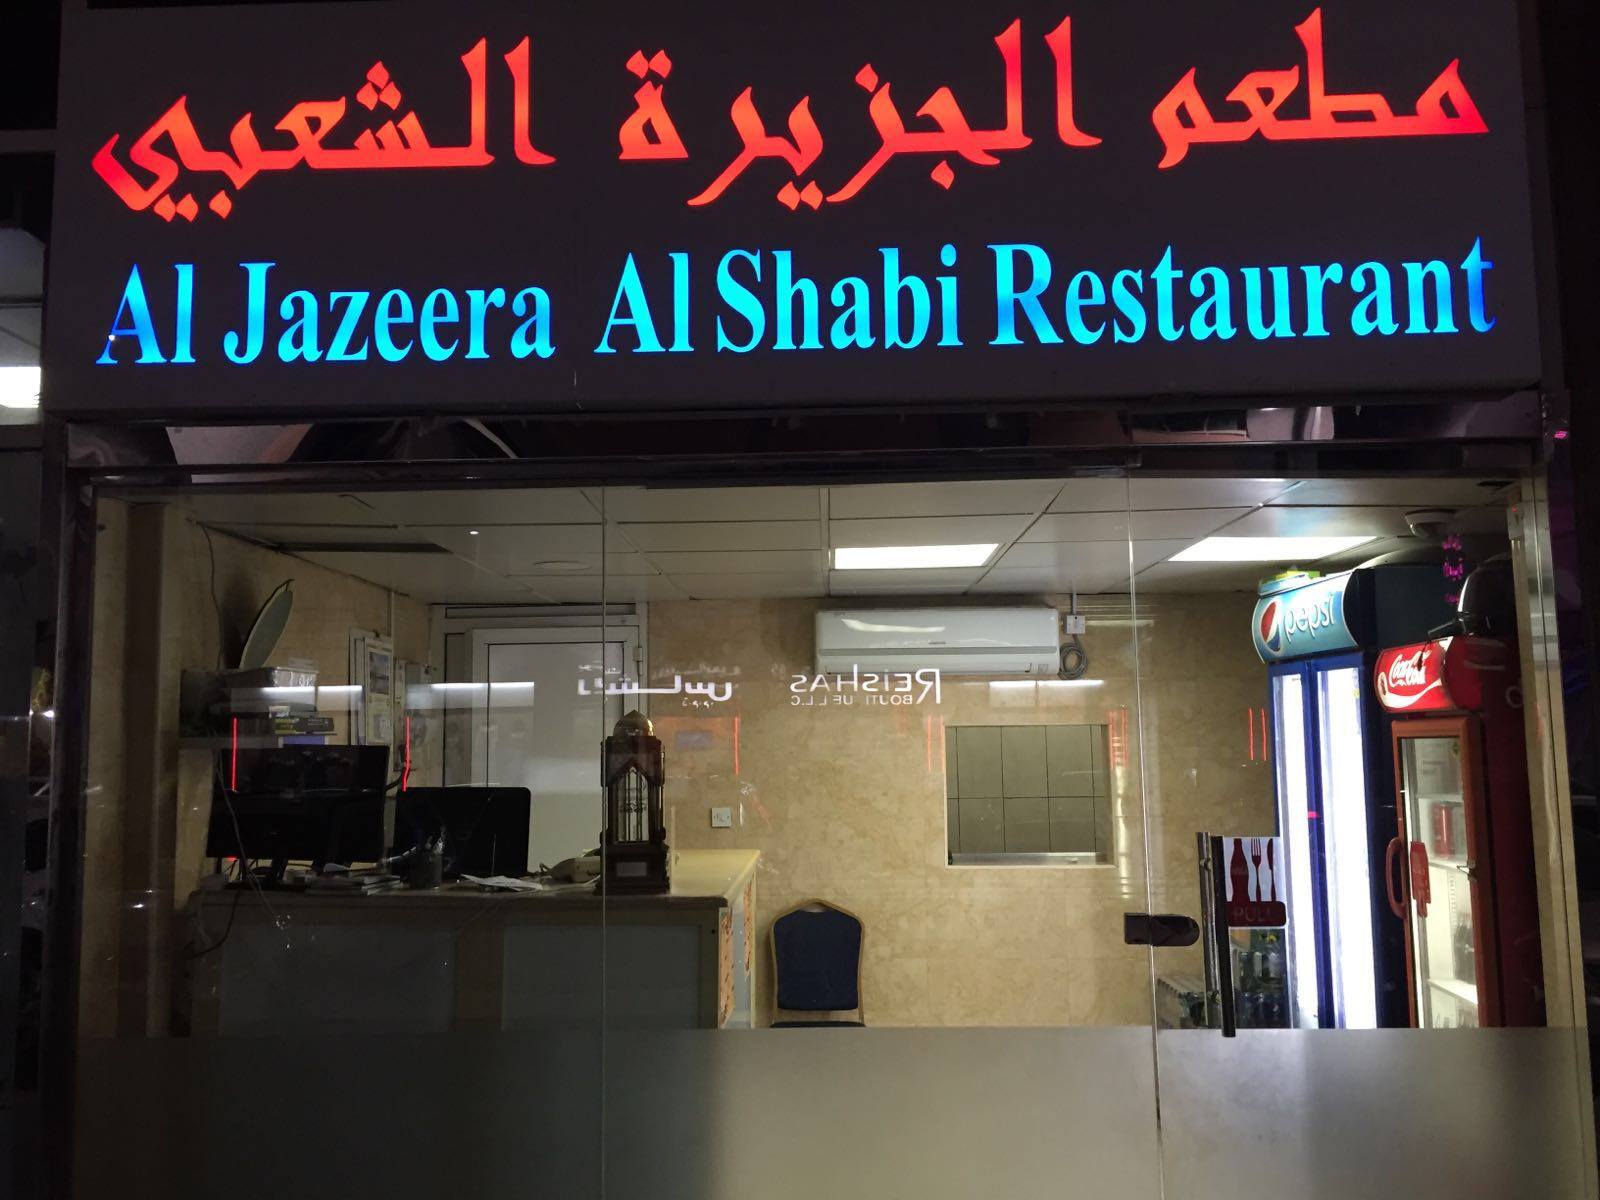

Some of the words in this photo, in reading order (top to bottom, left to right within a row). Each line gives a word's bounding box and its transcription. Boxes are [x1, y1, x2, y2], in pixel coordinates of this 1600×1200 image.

[92, 36, 556, 222] الشعبي
[618, 16, 1102, 211] الجزيرة
[1151, 7, 1489, 170] مطعم
[96, 263, 196, 365] Al
[223, 262, 556, 364] Jazeera
[594, 252, 694, 354] Al
[716, 244, 964, 353] Shabi
[987, 236, 1497, 346] Restaurant
[1284, 593, 1335, 642] pepsi
